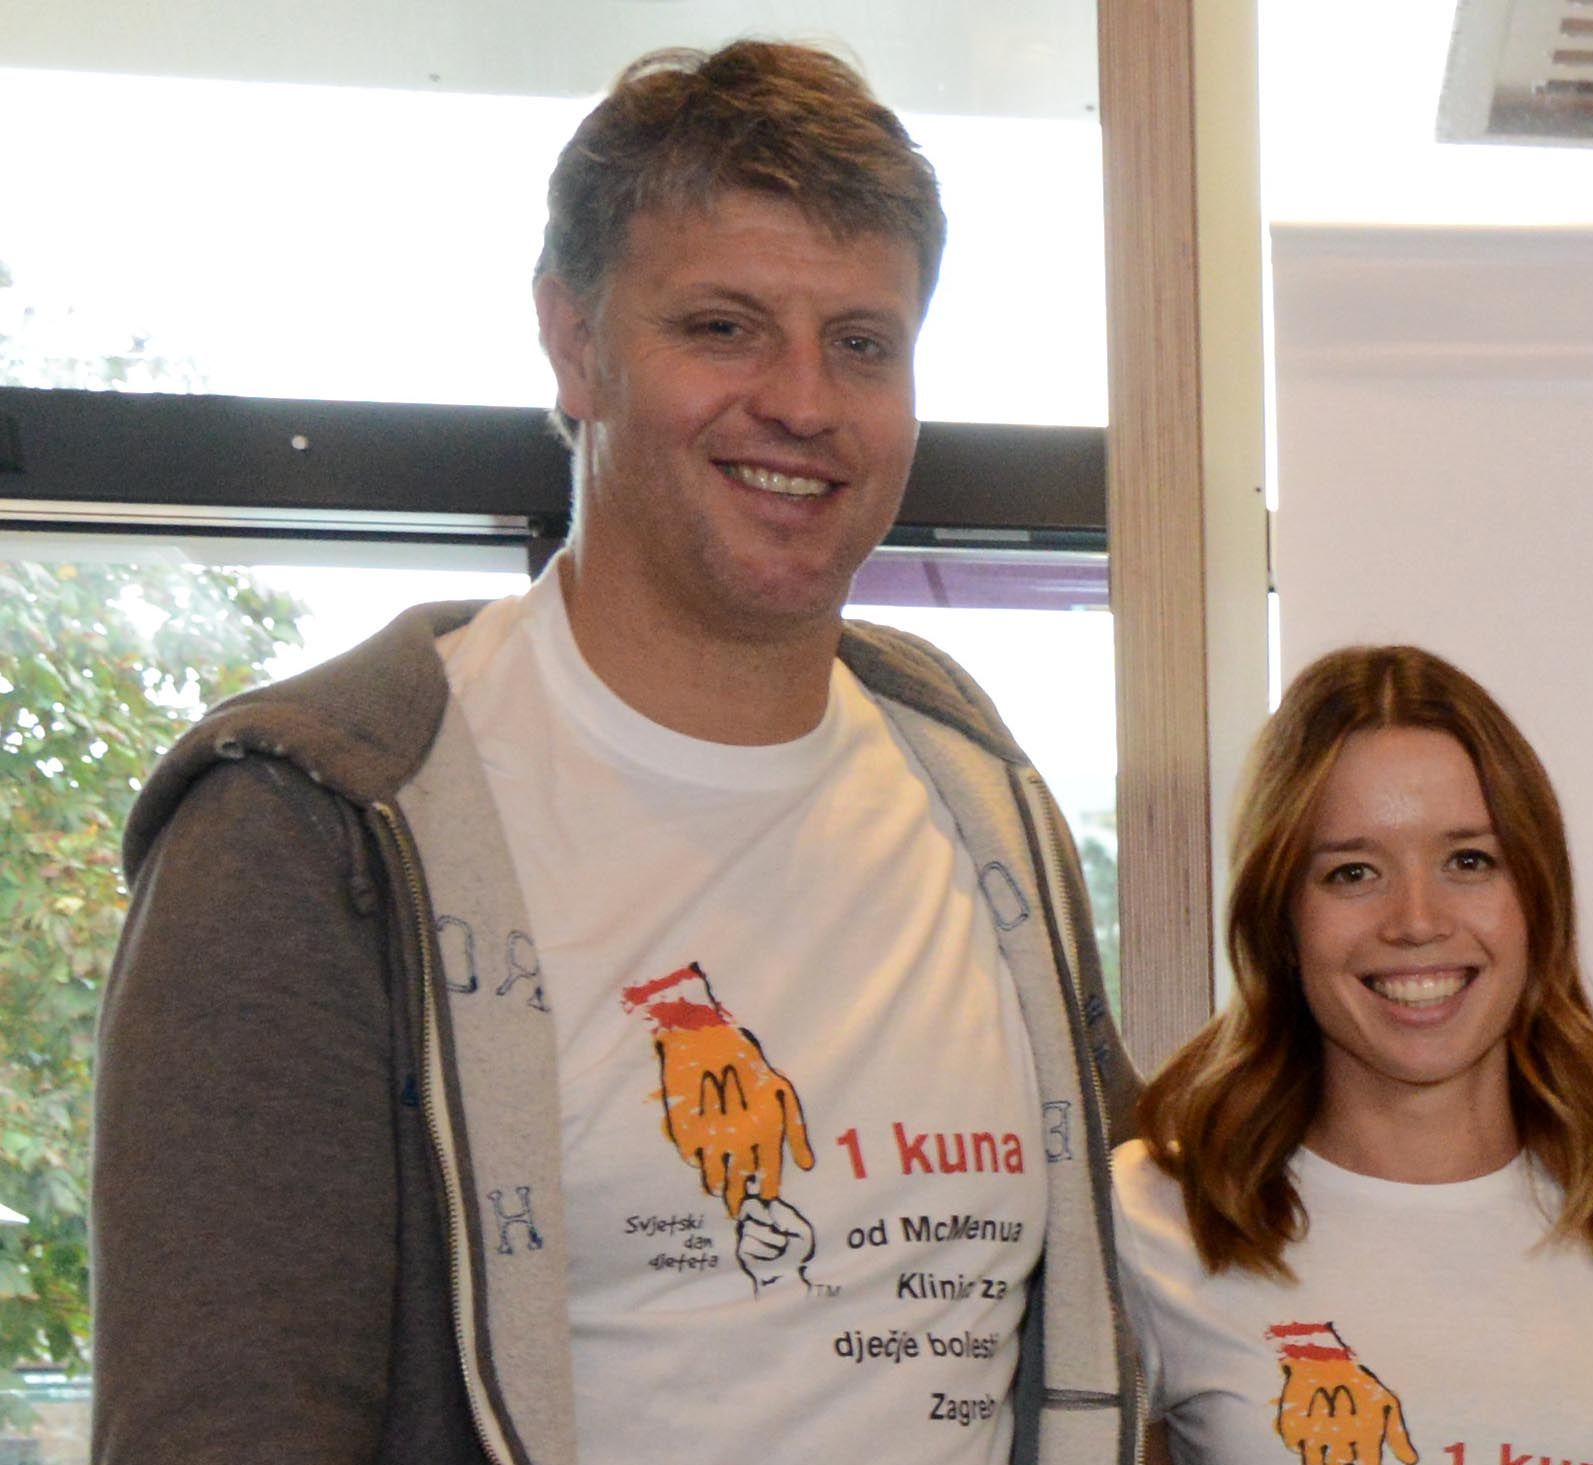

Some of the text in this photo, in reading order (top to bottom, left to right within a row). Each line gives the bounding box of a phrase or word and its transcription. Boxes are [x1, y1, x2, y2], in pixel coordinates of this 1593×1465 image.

[836, 1128, 867, 1180] 1
[893, 1122, 1025, 1176] kuna
[847, 1215, 1023, 1249] od McMenua
[834, 1330, 919, 1363] dječje
